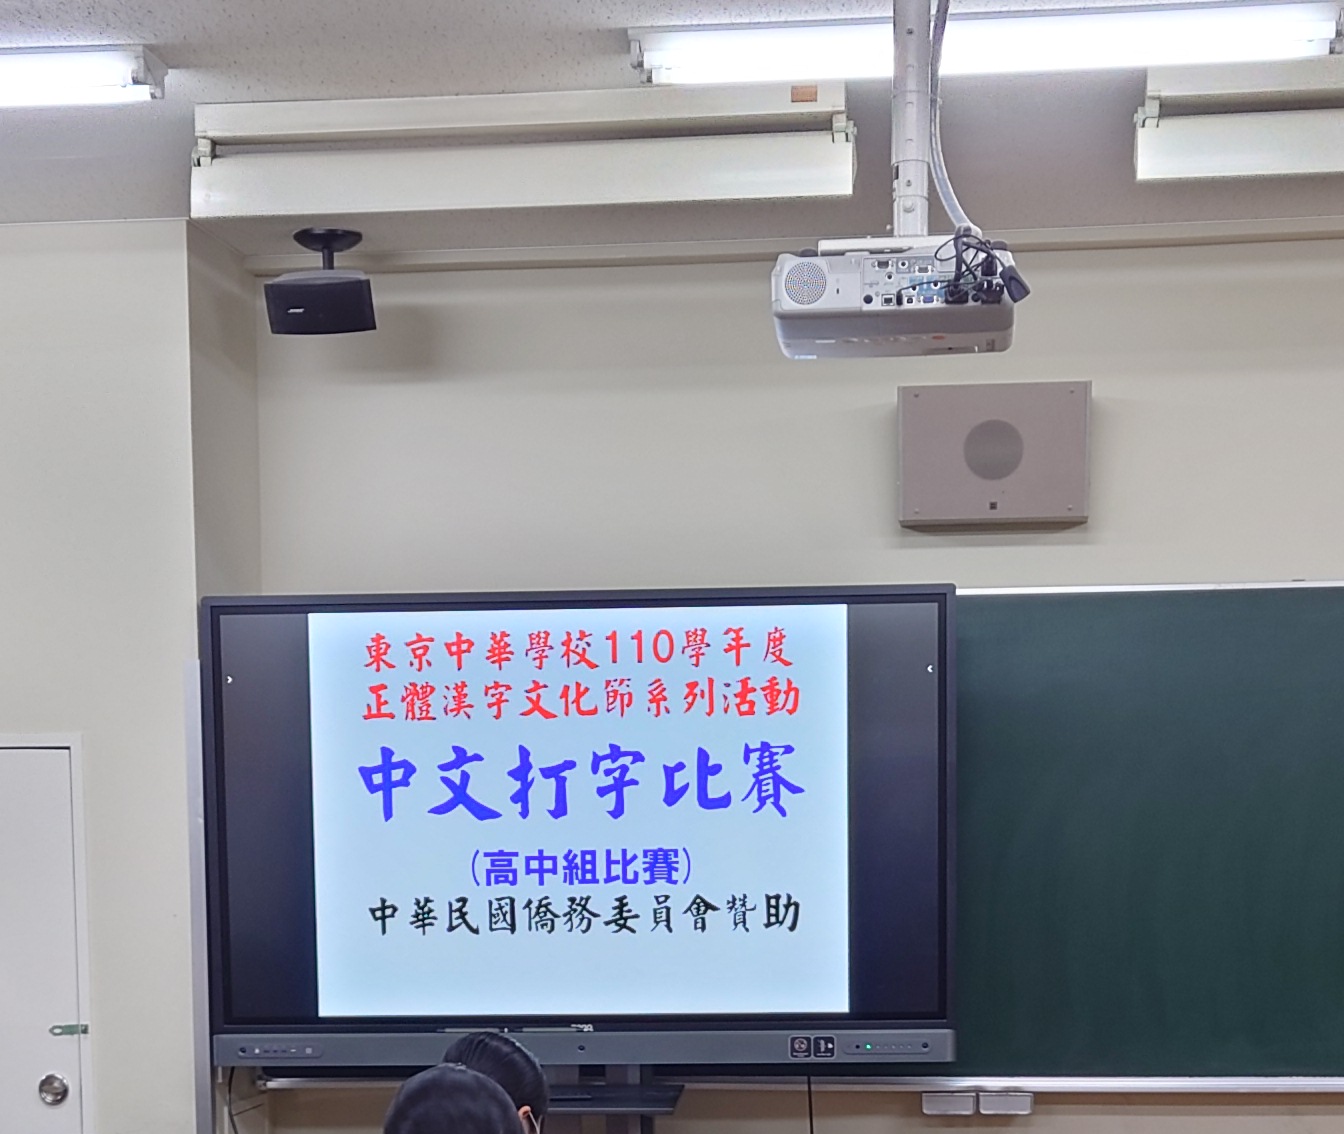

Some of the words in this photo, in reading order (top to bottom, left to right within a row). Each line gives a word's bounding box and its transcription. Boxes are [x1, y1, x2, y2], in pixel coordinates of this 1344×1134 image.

[364, 626, 793, 673] 東京中華學校110學年度
[362, 675, 800, 722] 正體漢字文化節系列活動
[357, 740, 806, 823] 中文打字比賽
[471, 847, 692, 887] (高中組比賽)
